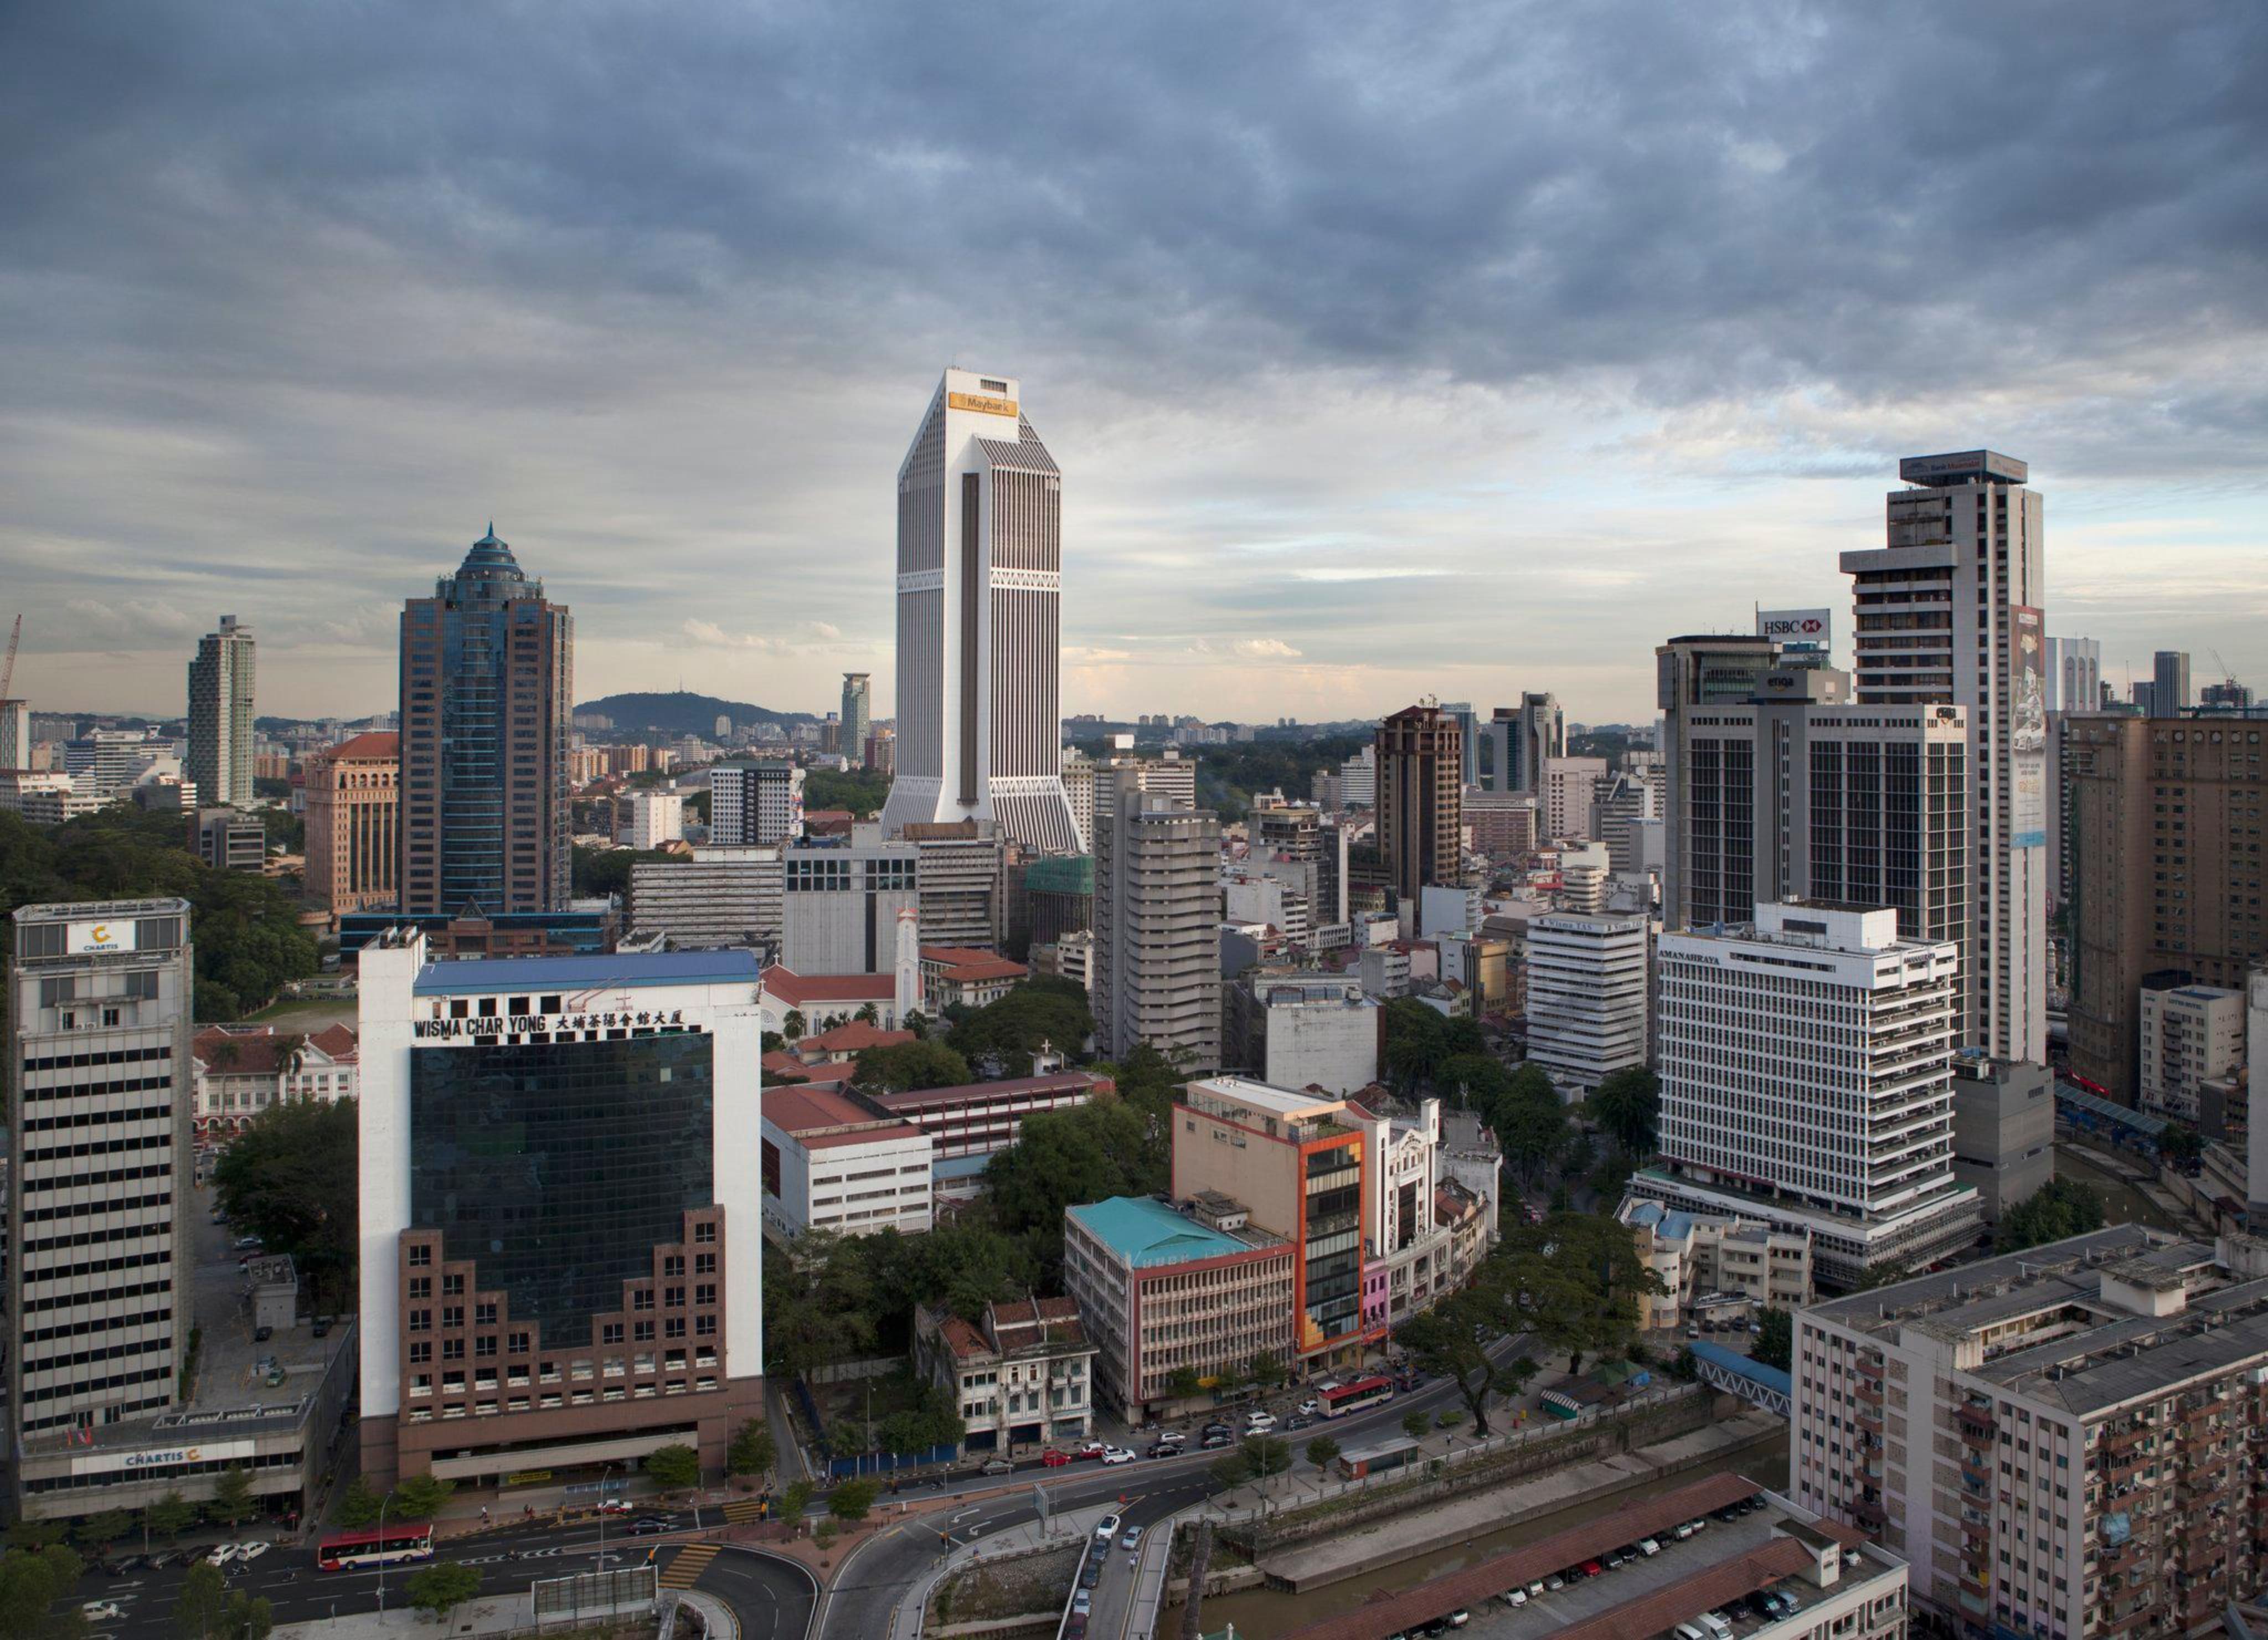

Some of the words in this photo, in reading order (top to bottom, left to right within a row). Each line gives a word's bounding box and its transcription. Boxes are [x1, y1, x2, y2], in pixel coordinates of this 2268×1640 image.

[967, 398, 1009, 412] Maybank
[1764, 620, 1800, 634] HSBC
[1659, 950, 1719, 965] AMANAHRAYA
[414, 1019, 461, 1038] WISMA
[467, 1017, 503, 1035] CHAR
[509, 1015, 546, 1033] YONG
[126, 1451, 183, 1466] CHARTIS
